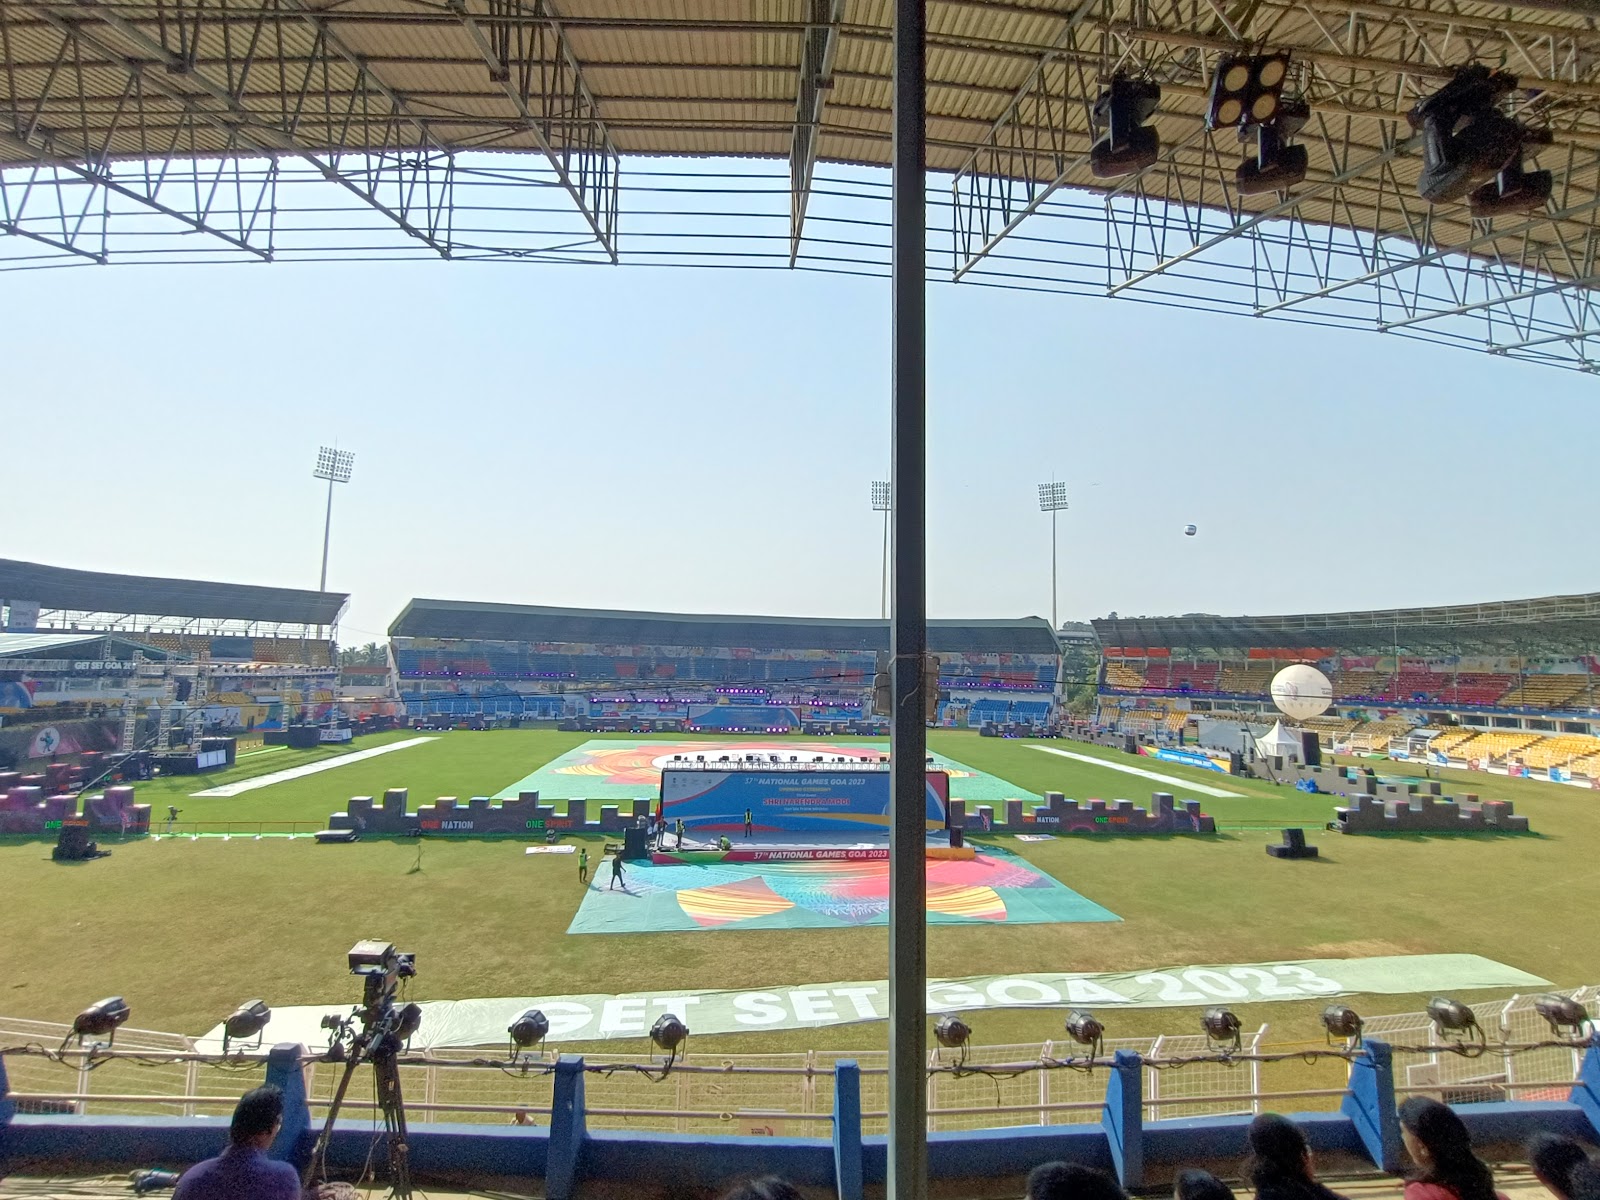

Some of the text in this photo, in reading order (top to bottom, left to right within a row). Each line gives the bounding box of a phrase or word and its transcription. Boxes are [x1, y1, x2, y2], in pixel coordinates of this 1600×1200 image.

[75, 662, 90, 670] GET
[92, 662, 104, 670] SET
[105, 662, 122, 670] GOA
[830, 778, 847, 786] GOA
[848, 778, 866, 786] 2023
[45, 820, 62, 829] ONE
[420, 820, 474, 829] ONE NATION
[525, 820, 544, 829] ONE
[769, 851, 814, 859] NATIONAL
[848, 850, 867, 858] GOA
[868, 850, 887, 858] 2023
[509, 965, 1343, 1036] GET SET GOA 2023
